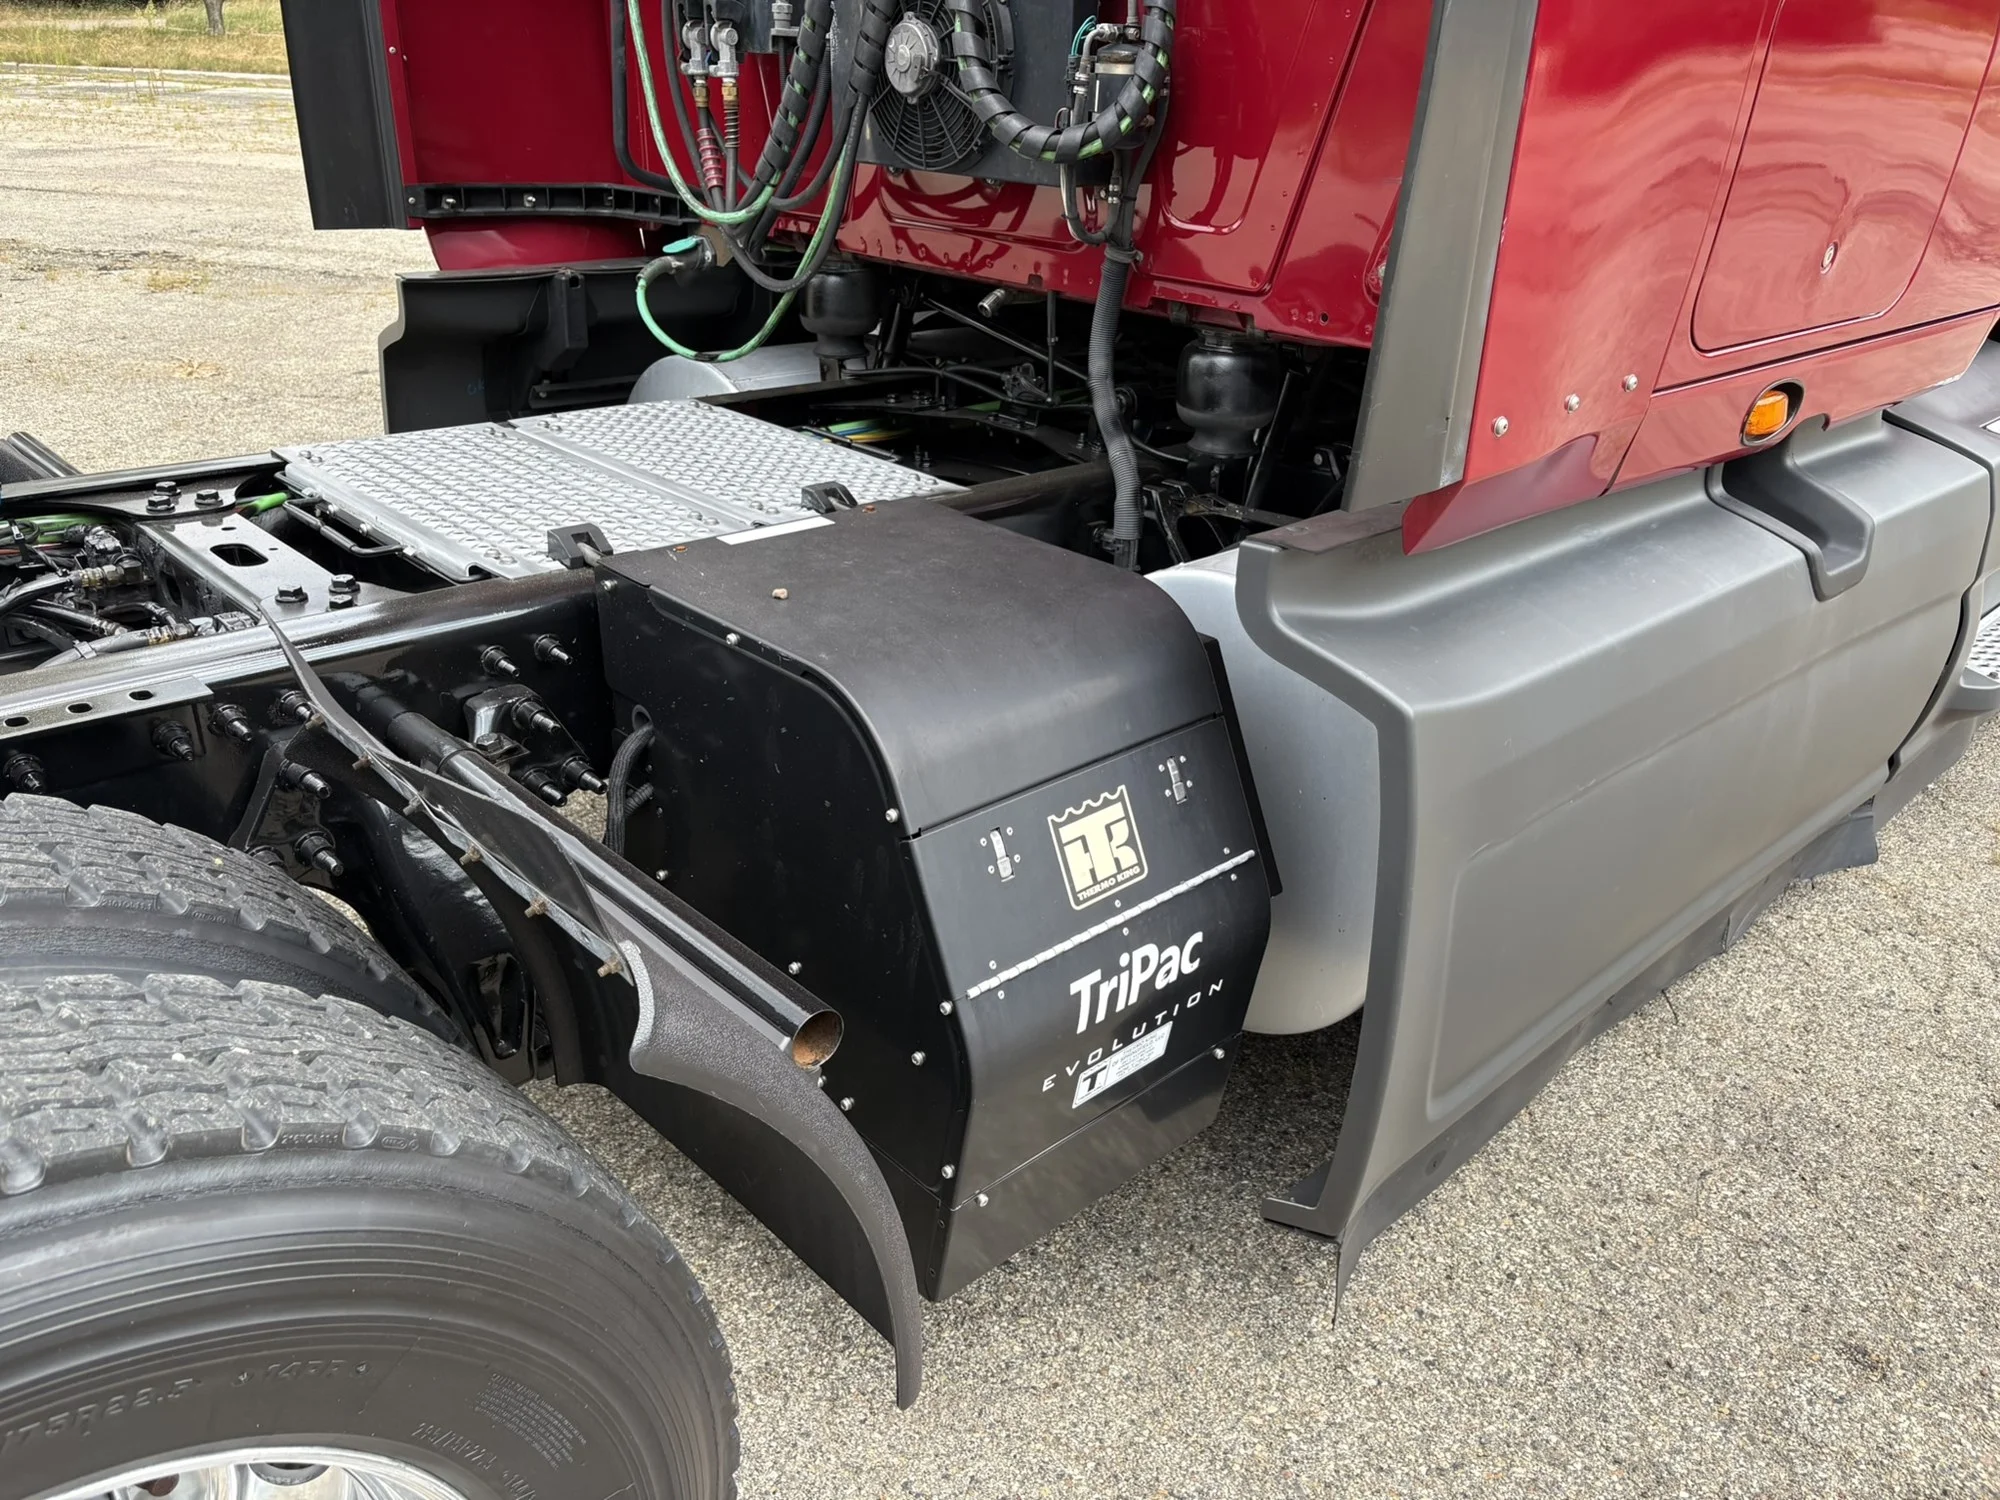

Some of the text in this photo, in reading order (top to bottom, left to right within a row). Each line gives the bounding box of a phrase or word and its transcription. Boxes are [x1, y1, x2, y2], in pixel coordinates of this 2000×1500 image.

[1077, 865, 1141, 901] THERMO KING
[1070, 931, 1203, 1034] TriPac
[1042, 979, 1223, 1092] EVOLUTION
